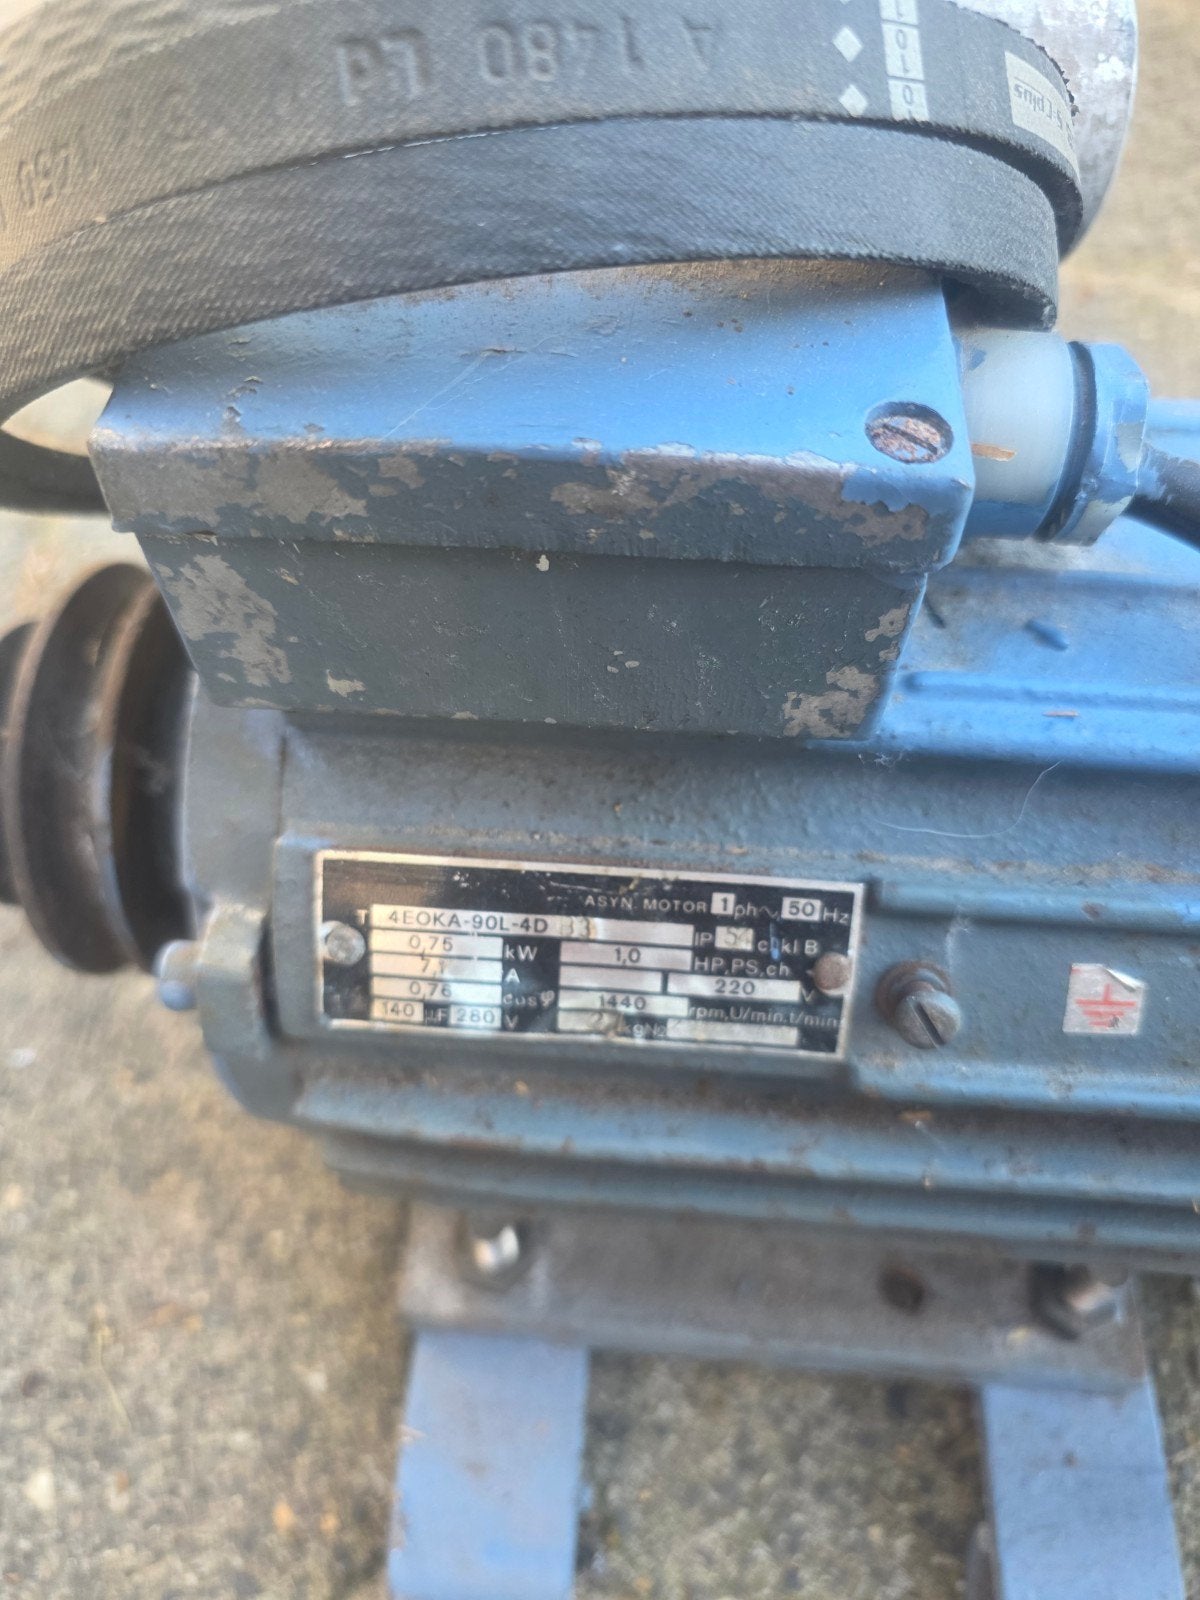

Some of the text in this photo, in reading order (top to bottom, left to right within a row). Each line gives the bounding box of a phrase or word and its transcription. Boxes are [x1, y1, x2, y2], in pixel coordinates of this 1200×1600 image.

[643, 899, 707, 913] MOTOR
[720, 897, 729, 912] 1
[788, 901, 815, 917] 50
[823, 907, 849, 925] Hz
[409, 935, 538, 962] 0,75 kW
[695, 932, 713, 946] IP
[804, 940, 819, 955] B
[613, 948, 641, 966] 1,0
[505, 968, 521, 984] A
[409, 982, 453, 1000] 0,76
[598, 993, 647, 1011] 1440
[714, 980, 815, 1002] 220 V
[382, 1002, 415, 1018] 140
[456, 1007, 496, 1025] 280
[505, 1015, 519, 1029] V
